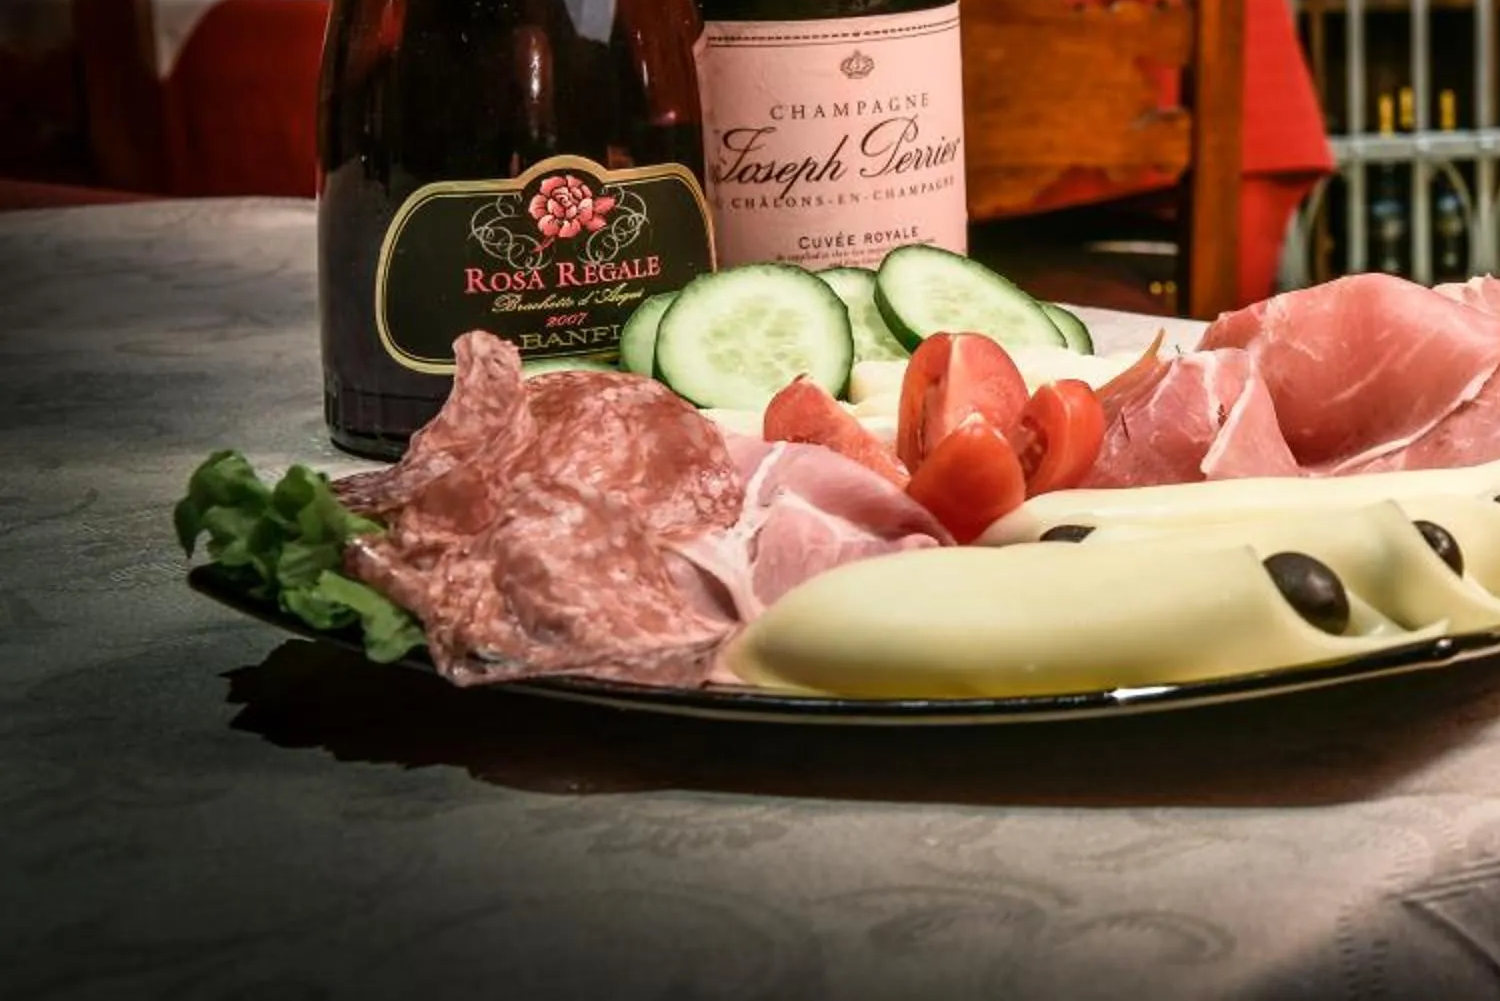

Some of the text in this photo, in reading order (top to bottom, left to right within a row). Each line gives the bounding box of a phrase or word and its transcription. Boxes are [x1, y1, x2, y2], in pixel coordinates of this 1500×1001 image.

[770, 92, 929, 121] CHAMPAGNE
[714, 113, 961, 200] Joseph Perrier
[798, 232, 856, 250] CUVÉE
[863, 225, 919, 244] ROYALE
[464, 255, 662, 294] ROSA REGALE
[545, 312, 589, 328] 2007
[520, 324, 622, 350] BANFI
